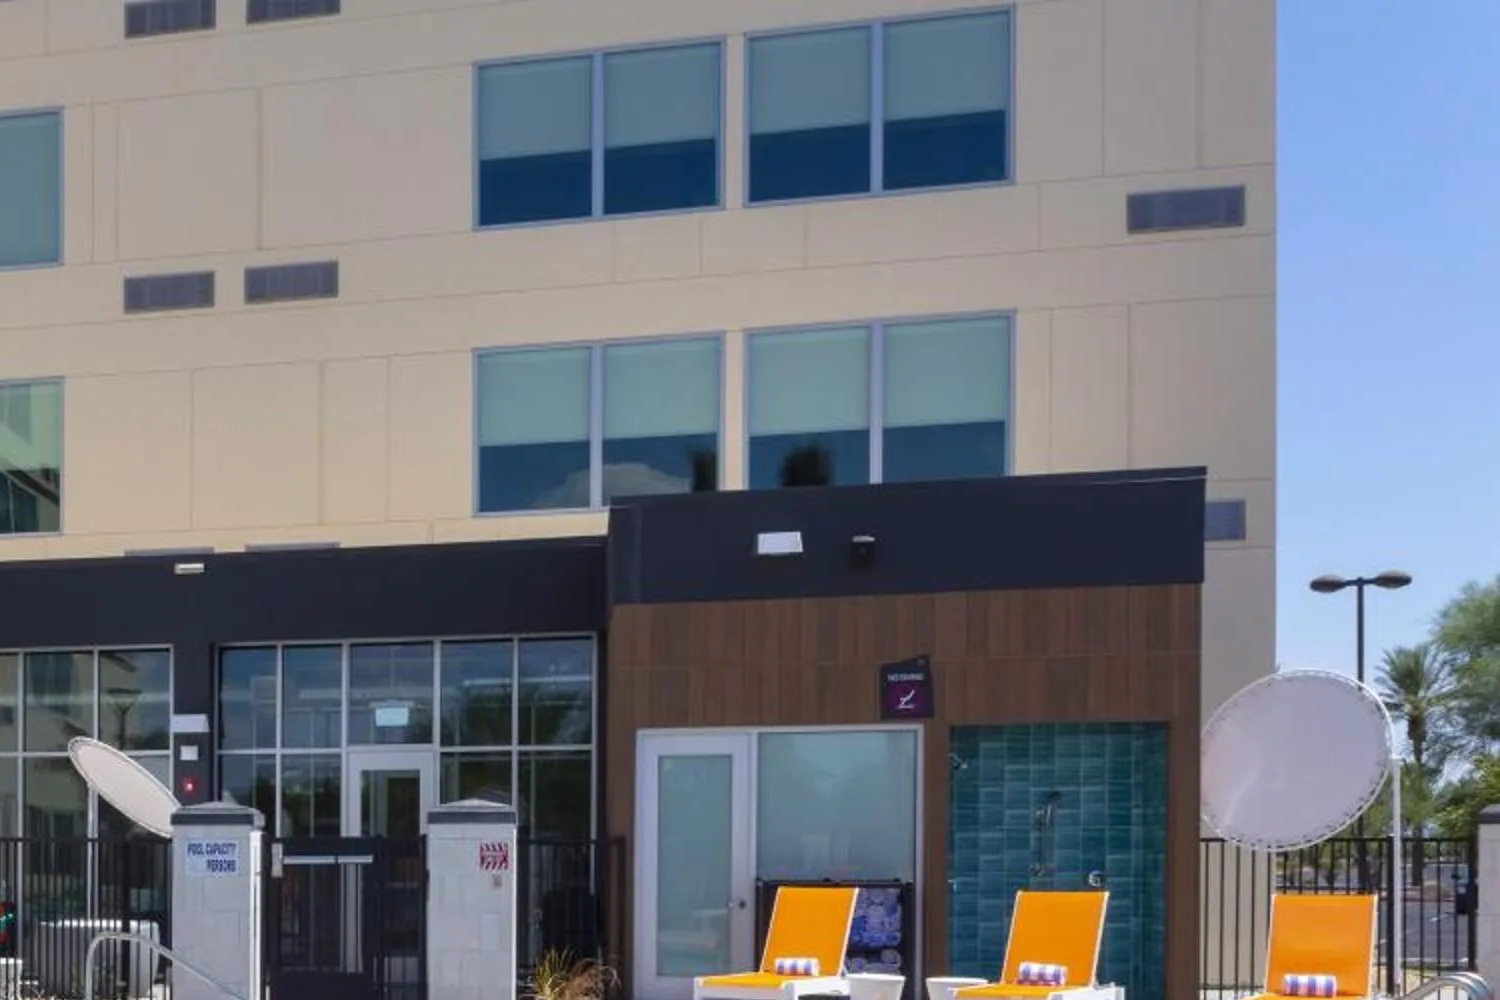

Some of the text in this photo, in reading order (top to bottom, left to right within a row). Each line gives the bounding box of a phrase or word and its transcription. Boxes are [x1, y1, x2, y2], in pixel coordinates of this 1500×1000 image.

[188, 843, 236, 856] POOL CAPACITY
[206, 859, 236, 872] PERSONS
